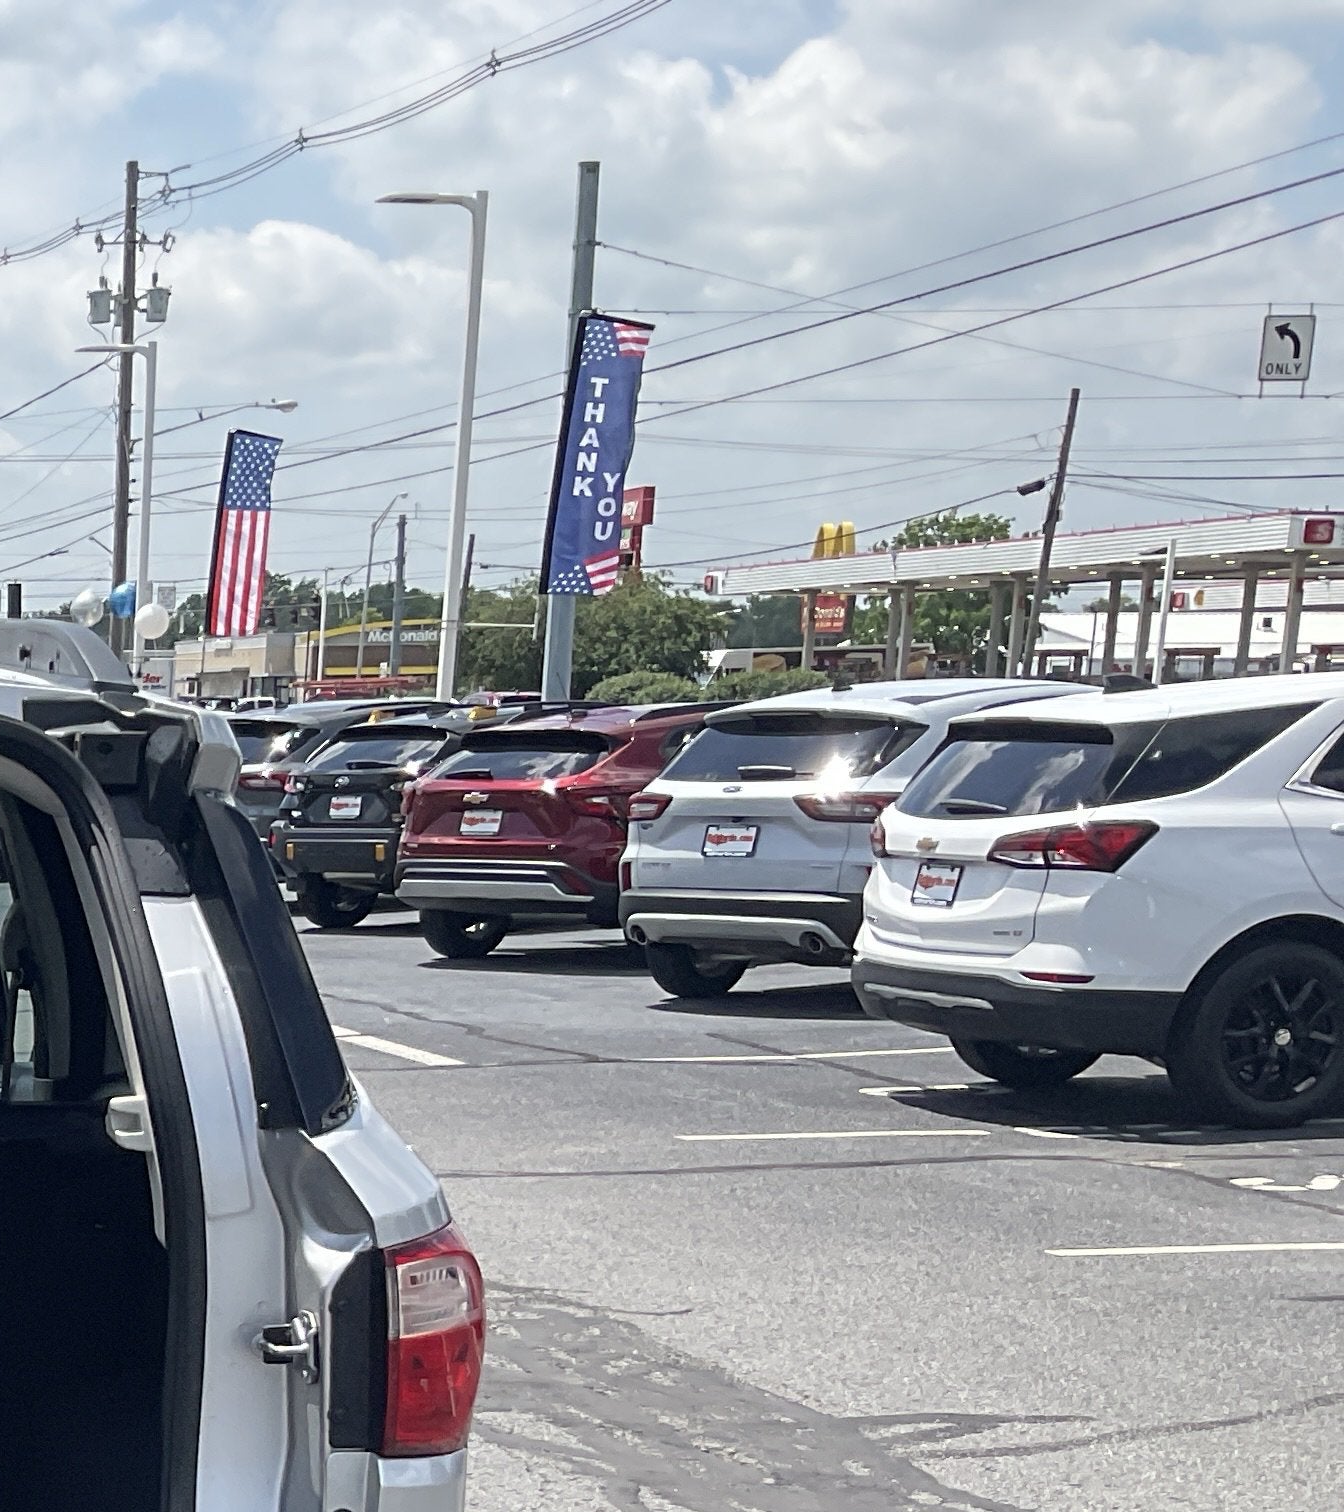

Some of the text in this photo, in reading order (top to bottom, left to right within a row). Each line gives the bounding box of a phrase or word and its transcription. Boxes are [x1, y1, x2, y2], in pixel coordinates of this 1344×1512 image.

[1265, 362, 1303, 375] ONLY
[572, 376, 610, 497] THANK
[593, 472, 621, 541] YOU
[367, 629, 438, 643] Mconald
